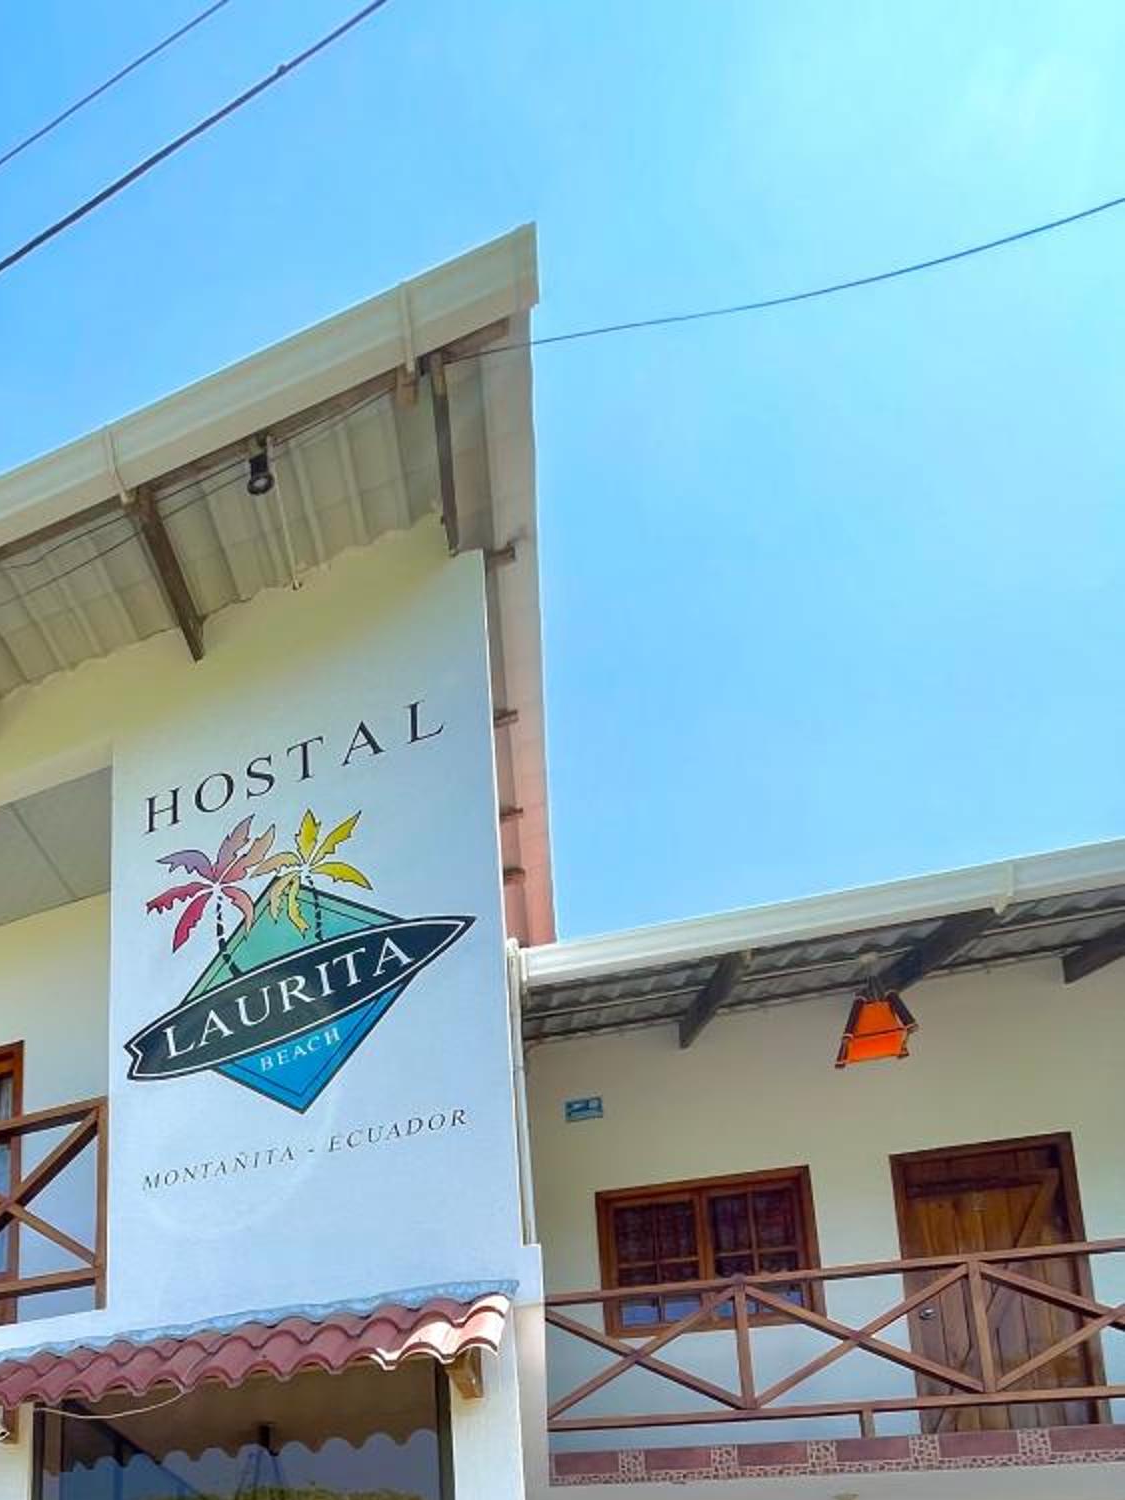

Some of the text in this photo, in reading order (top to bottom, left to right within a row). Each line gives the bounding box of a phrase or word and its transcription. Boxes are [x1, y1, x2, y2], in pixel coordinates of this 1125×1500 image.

[143, 699, 445, 835] HOSTAL
[162, 937, 415, 1060] LAURITA
[260, 1028, 342, 1073] BEACH
[141, 1144, 296, 1192] MONTAÑITA
[328, 1107, 467, 1153] ECUADOR
